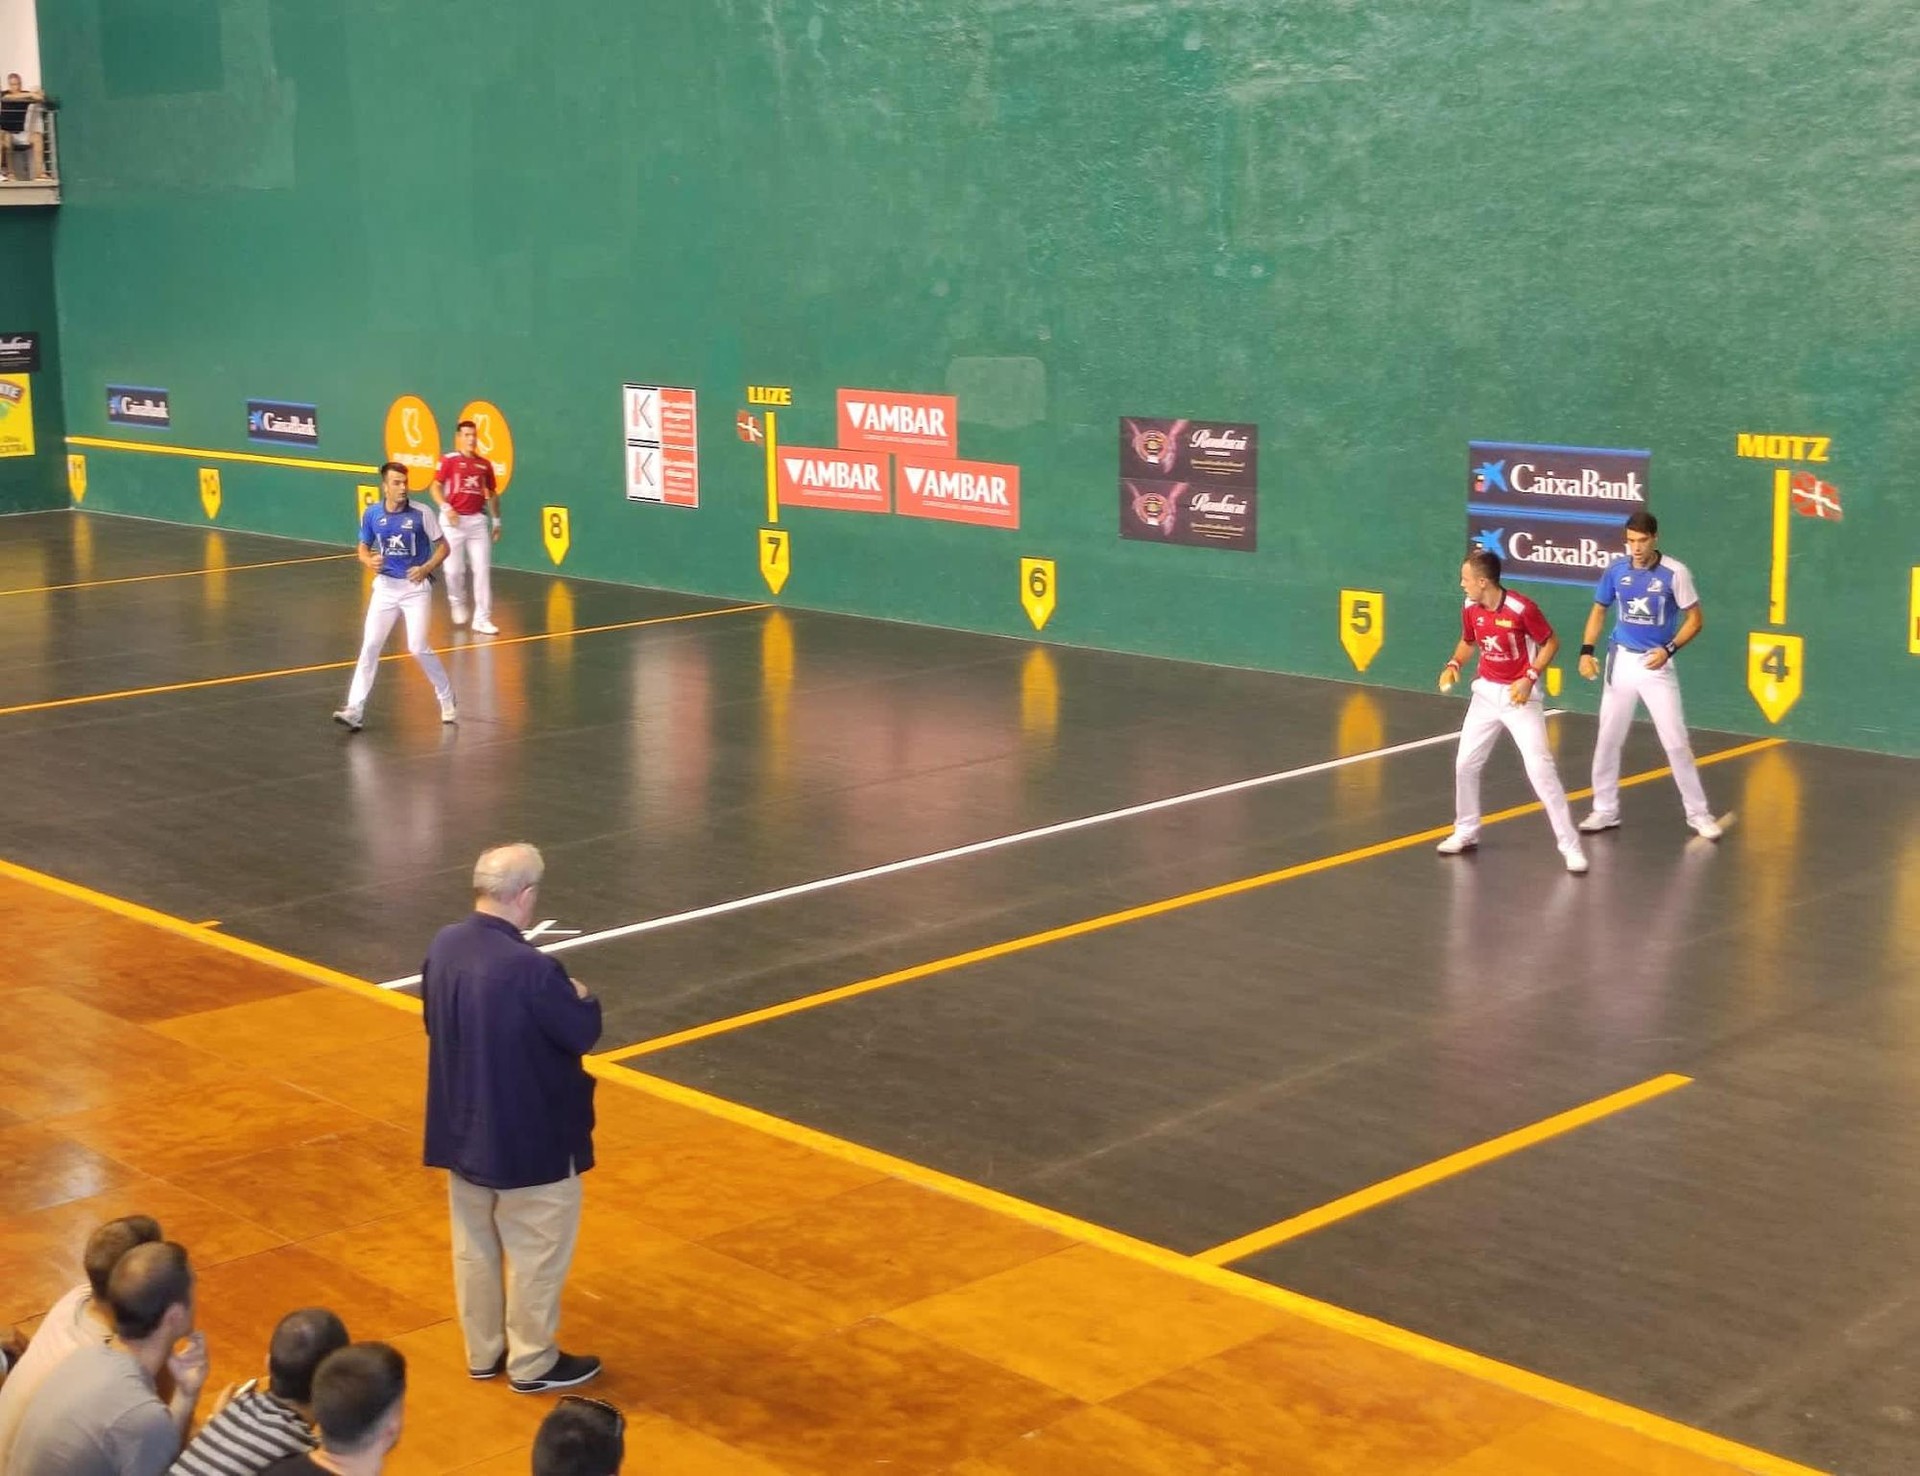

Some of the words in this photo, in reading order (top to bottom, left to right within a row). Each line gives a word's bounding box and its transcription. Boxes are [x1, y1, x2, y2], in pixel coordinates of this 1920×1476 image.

[863, 403, 948, 437] AMBAR
[1737, 433, 1831, 461] MOTZ
[802, 461, 882, 491] AMBAR
[922, 467, 1009, 506] AMBAR
[1510, 463, 1645, 502] CaixaBank
[549, 512, 563, 539] 8
[767, 536, 781, 565] 7
[1508, 532, 1632, 568] CaixaBa
[1029, 567, 1047, 598] 6
[1350, 599, 1372, 635] 5
[1761, 645, 1790, 683] 4
